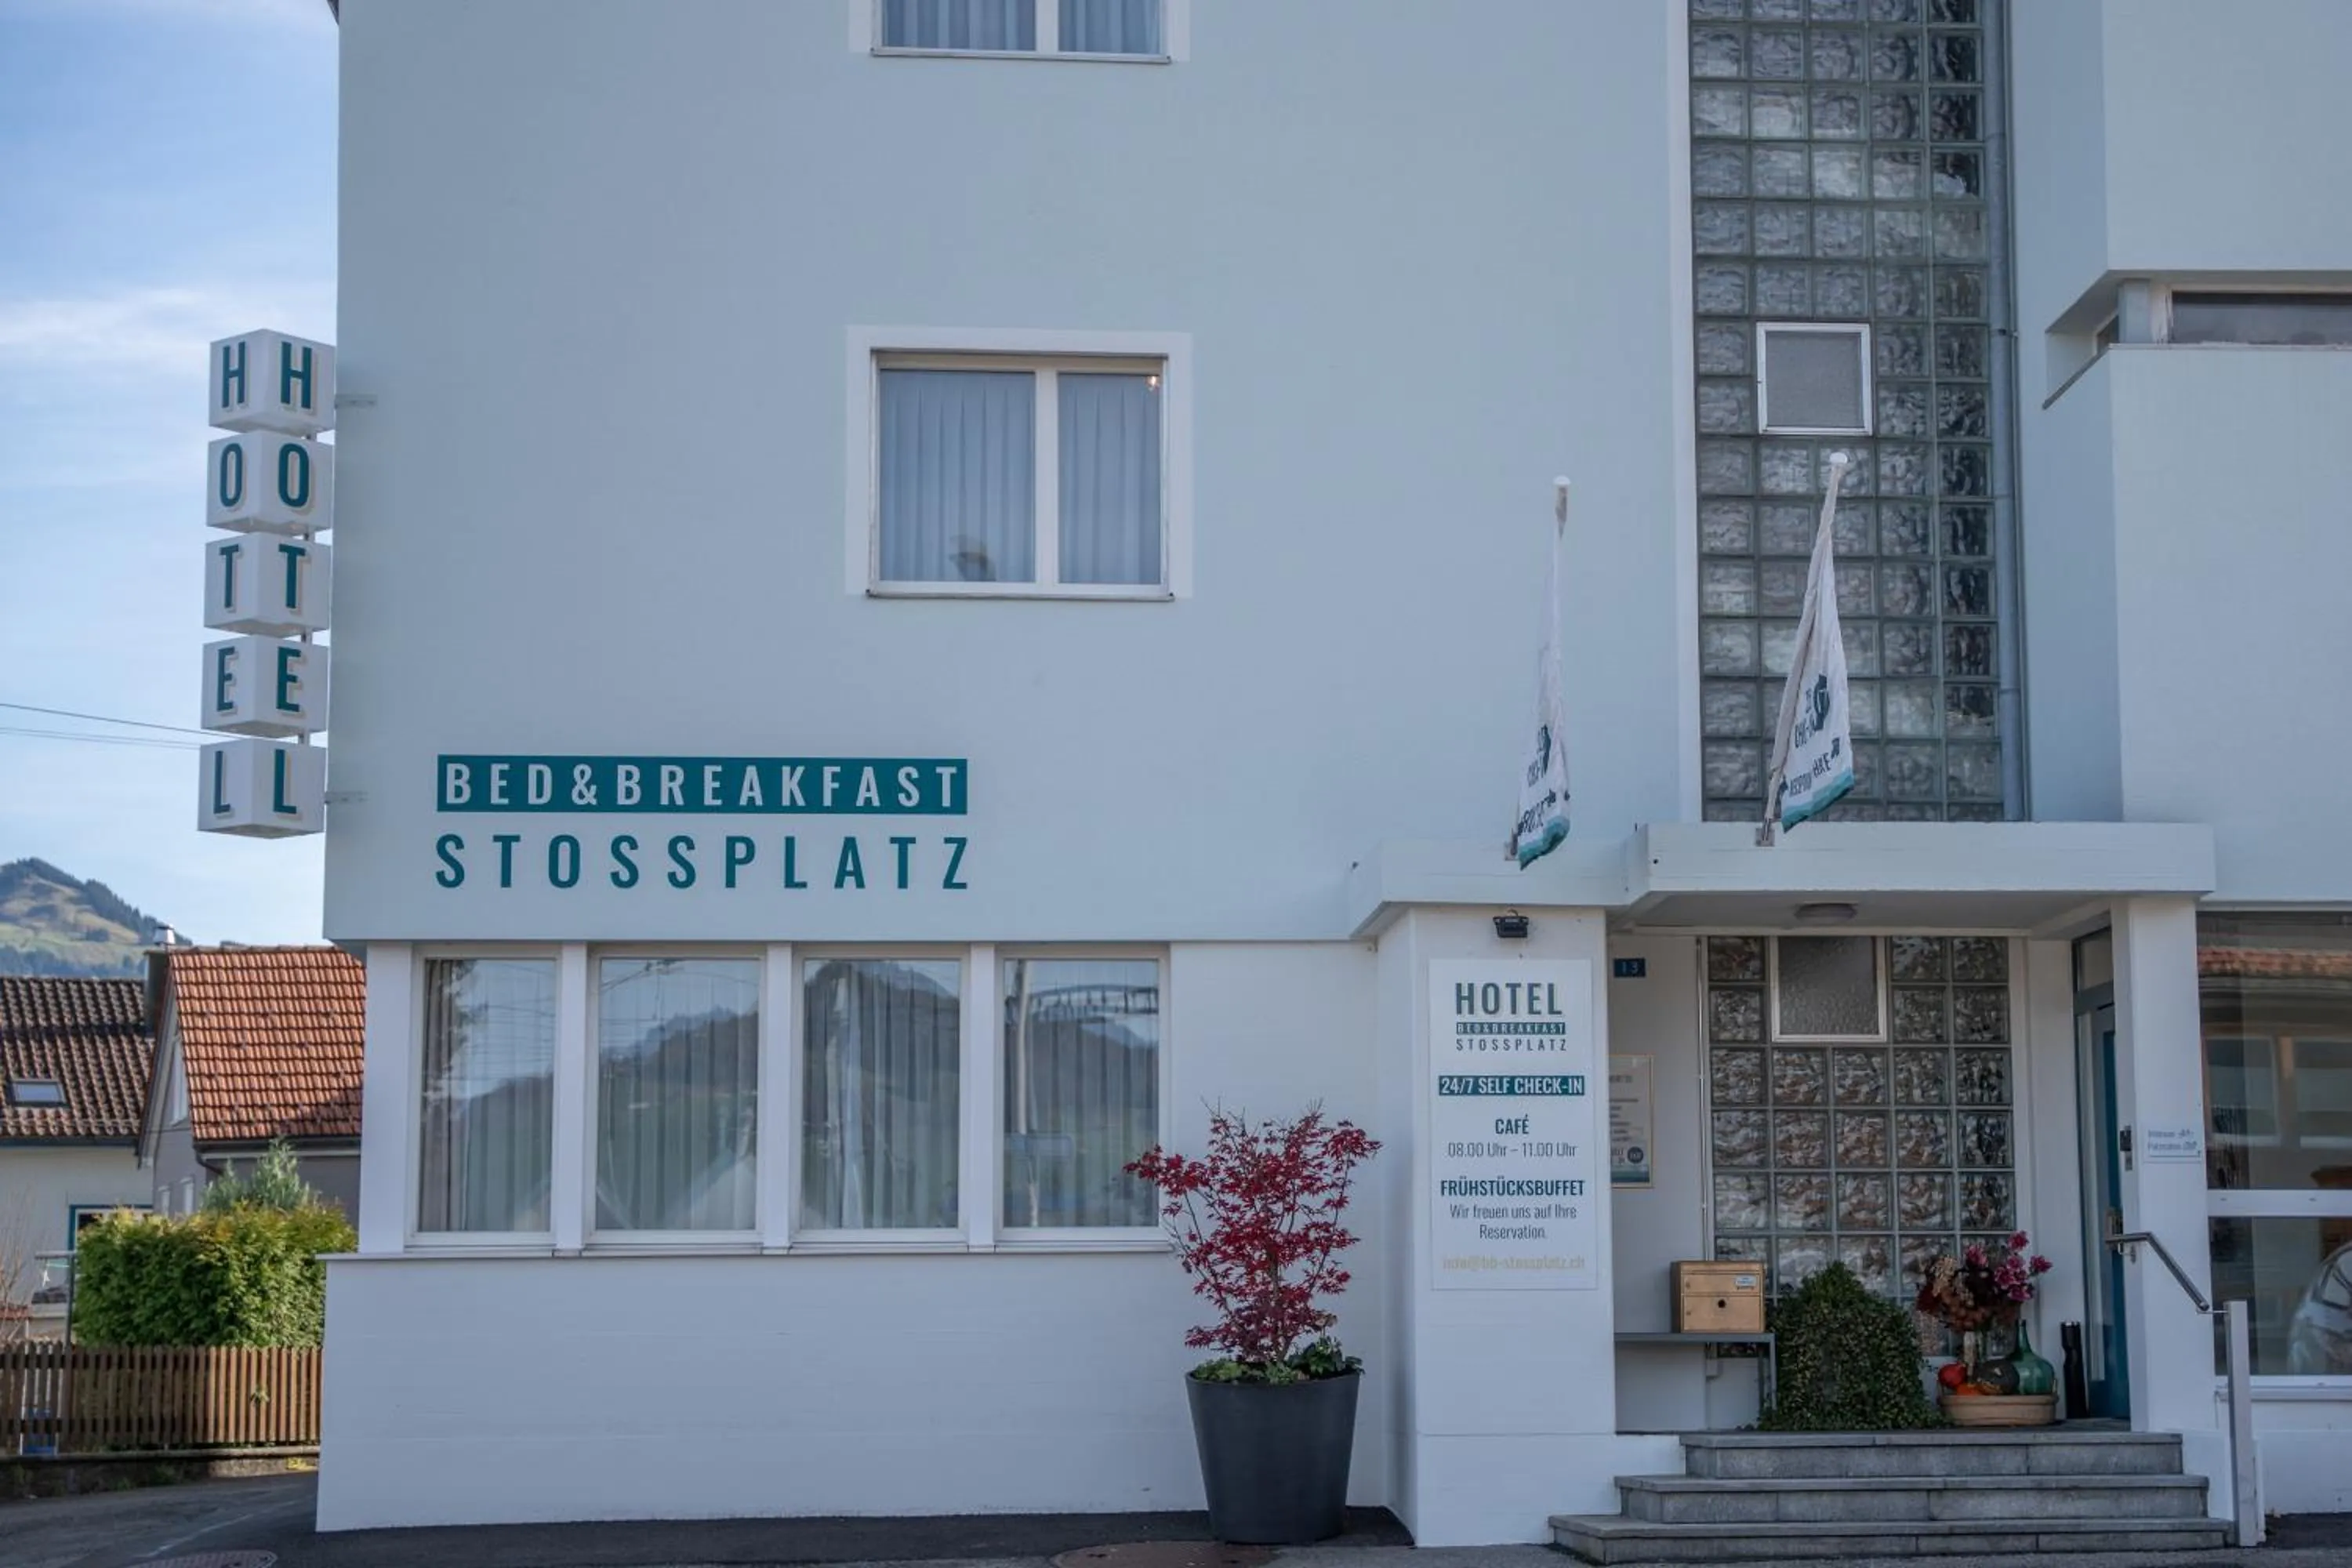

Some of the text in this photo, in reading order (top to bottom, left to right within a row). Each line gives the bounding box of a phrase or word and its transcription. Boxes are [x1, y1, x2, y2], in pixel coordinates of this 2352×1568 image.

[213, 342, 246, 814] HOTEL
[273, 341, 312, 814] HOTEL
[445, 763, 957, 808] BED&BREAKFAST
[435, 833, 969, 890] STOSSPLATZ
[1455, 982, 1563, 1015] HOTEL
[1456, 1038, 1566, 1051] STOSSPLATZ
[1441, 1076, 1583, 1094] 24/7 SELF CHECK-IN
[1495, 1113, 1530, 1134] CAFÉ
[1447, 1142, 1484, 1158] 08.00
[1487, 1142, 1508, 1158] Uhr
[1522, 1142, 1553, 1158] 11.00
[1556, 1142, 1577, 1158] Uhr
[1440, 1176, 1585, 1196] FRÜHSTÜCKSBUFFET
[1450, 1204, 1577, 1219] Wir freuen uns auf Ihre
